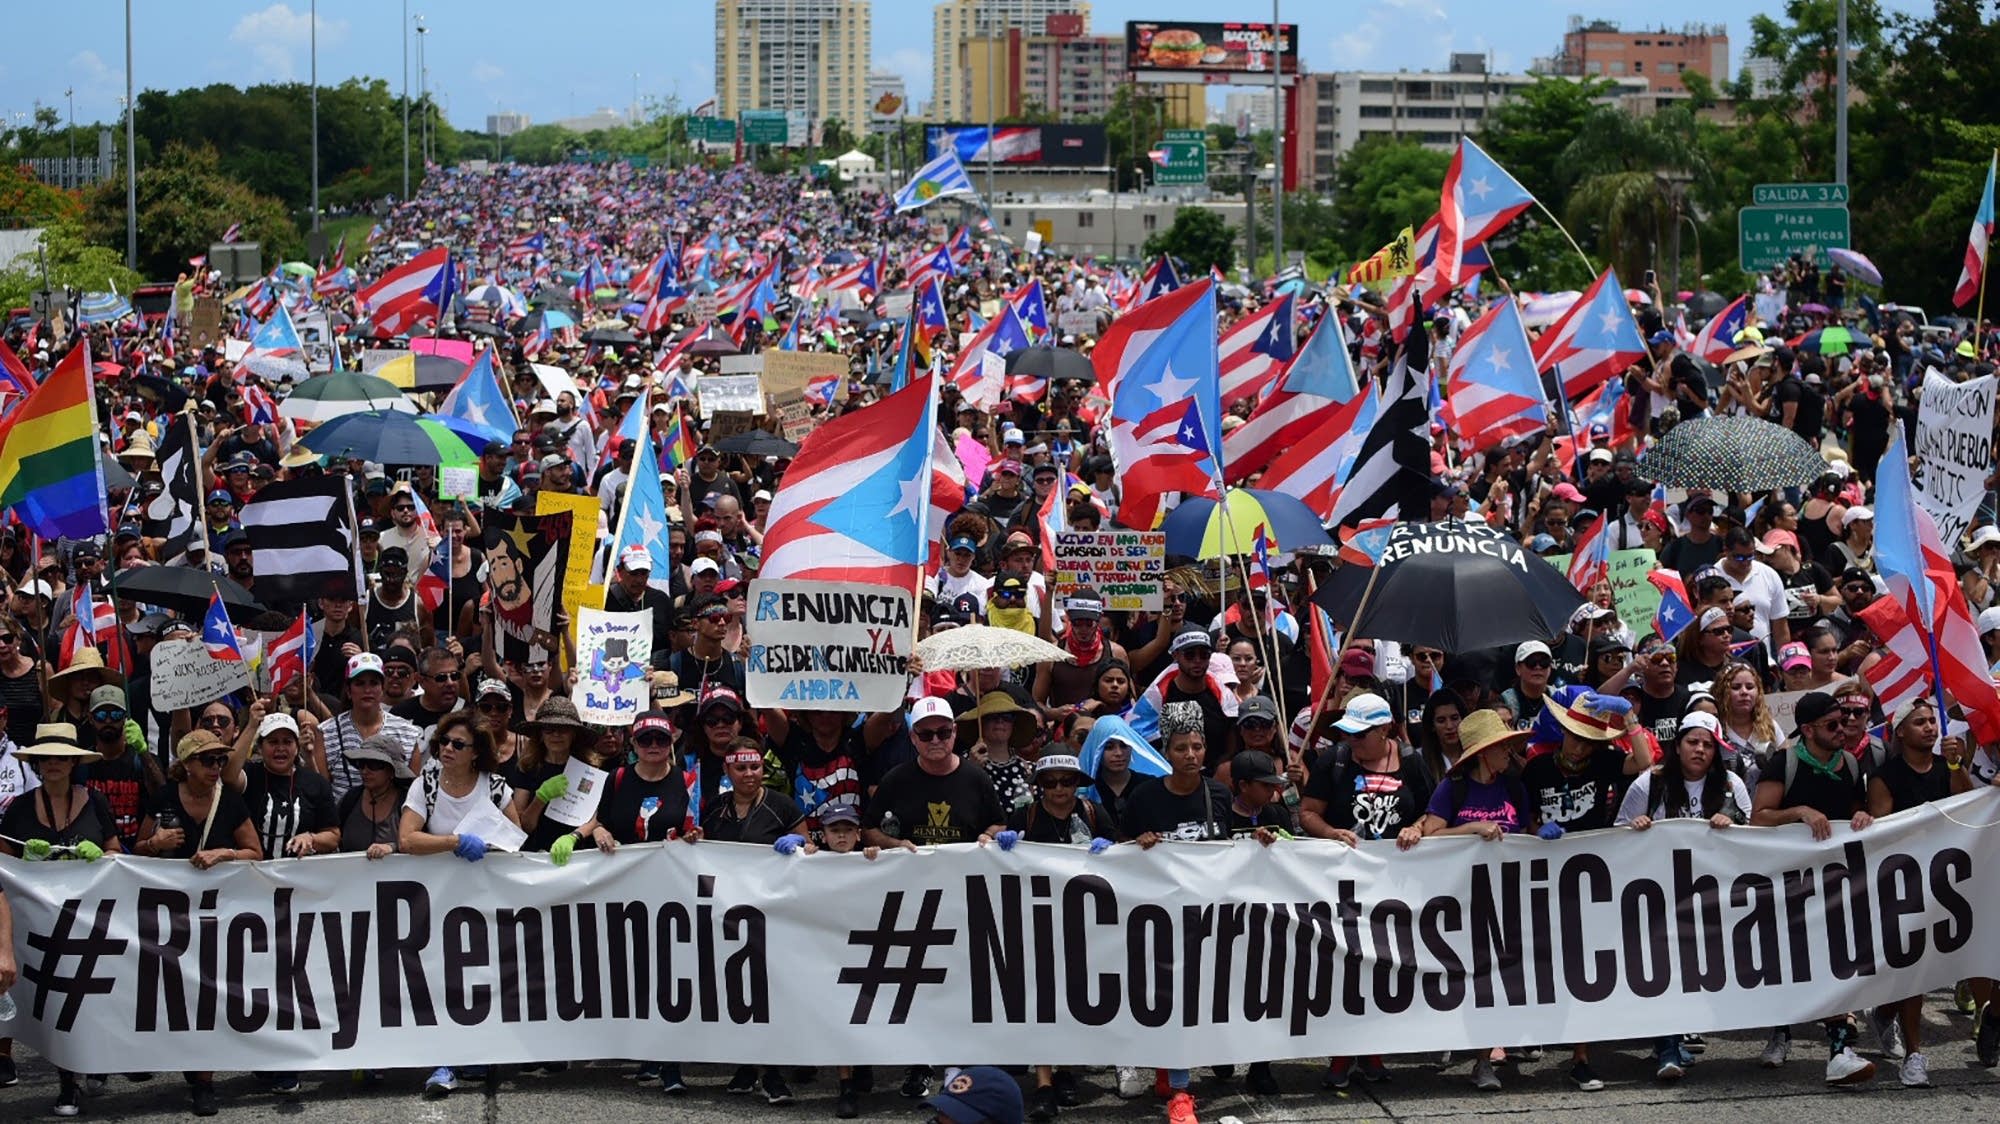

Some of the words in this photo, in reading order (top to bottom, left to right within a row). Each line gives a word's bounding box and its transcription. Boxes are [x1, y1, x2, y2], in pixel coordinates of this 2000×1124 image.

[1759, 188, 1810, 201] SALIDA
[1775, 213, 1814, 225] Plaza
[1745, 230, 1770, 242] Las
[1781, 229, 1844, 241] Americas
[1947, 428, 1990, 471] PUEBLO
[1097, 535, 1114, 545] EN
[1110, 547, 1125, 557] DE
[1126, 546, 1147, 557] SER
[1380, 535, 1529, 573] RENUNCIA
[1077, 573, 1090, 583] LA
[755, 591, 909, 628] RENUNCIA
[629, 624, 640, 634] A
[867, 628, 895, 655] YA
[174, 661, 197, 678] RICKY
[780, 679, 860, 700] AHORA
[586, 692, 609, 710] Bad
[613, 696, 638, 713] Boy
[1, 766, 15, 780] de
[913, 826, 961, 838] RENUNCIA
[22, 874, 770, 1050] #RickyRenuncia
[836, 840, 1974, 1037] #NiCorruptosNiCobardes
